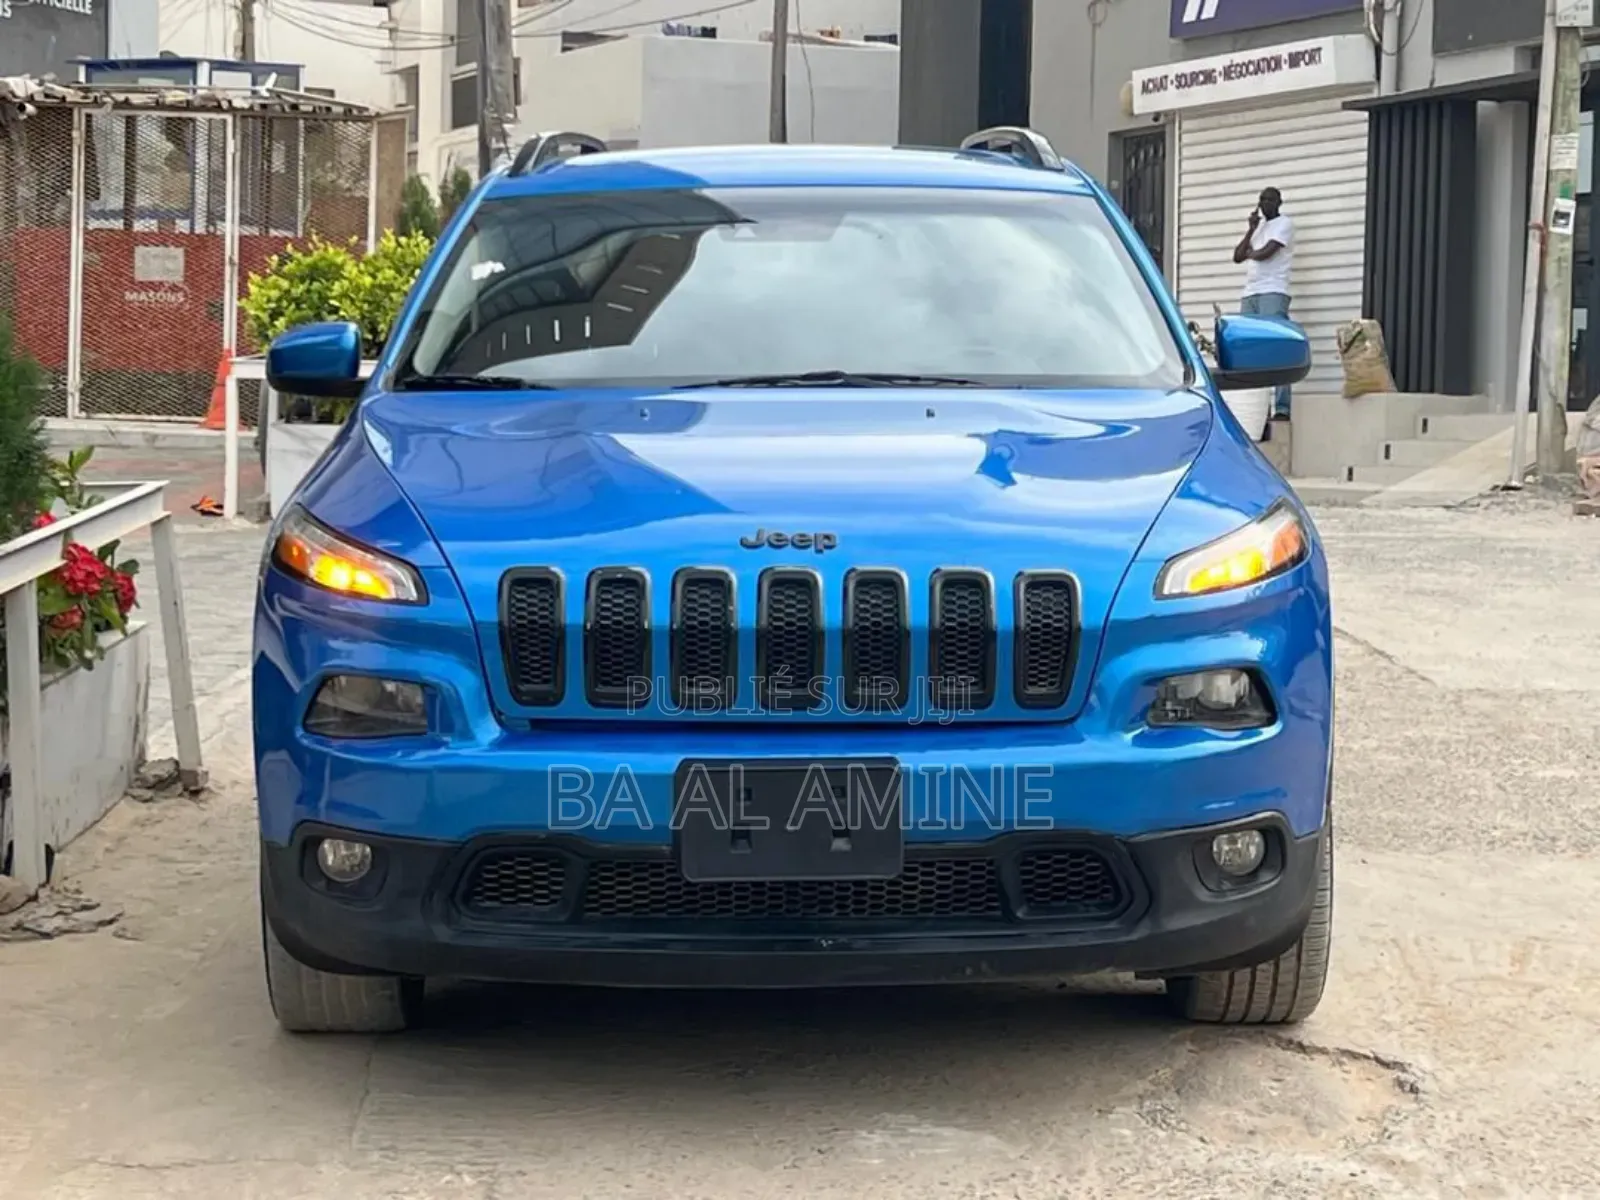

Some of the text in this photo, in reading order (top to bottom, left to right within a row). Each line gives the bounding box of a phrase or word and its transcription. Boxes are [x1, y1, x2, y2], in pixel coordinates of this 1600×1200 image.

[1141, 74, 1169, 96] ACHAT
[1174, 68, 1217, 90] SOURCING
[1288, 47, 1323, 69] IMPORT
[740, 528, 837, 554] Jeep
